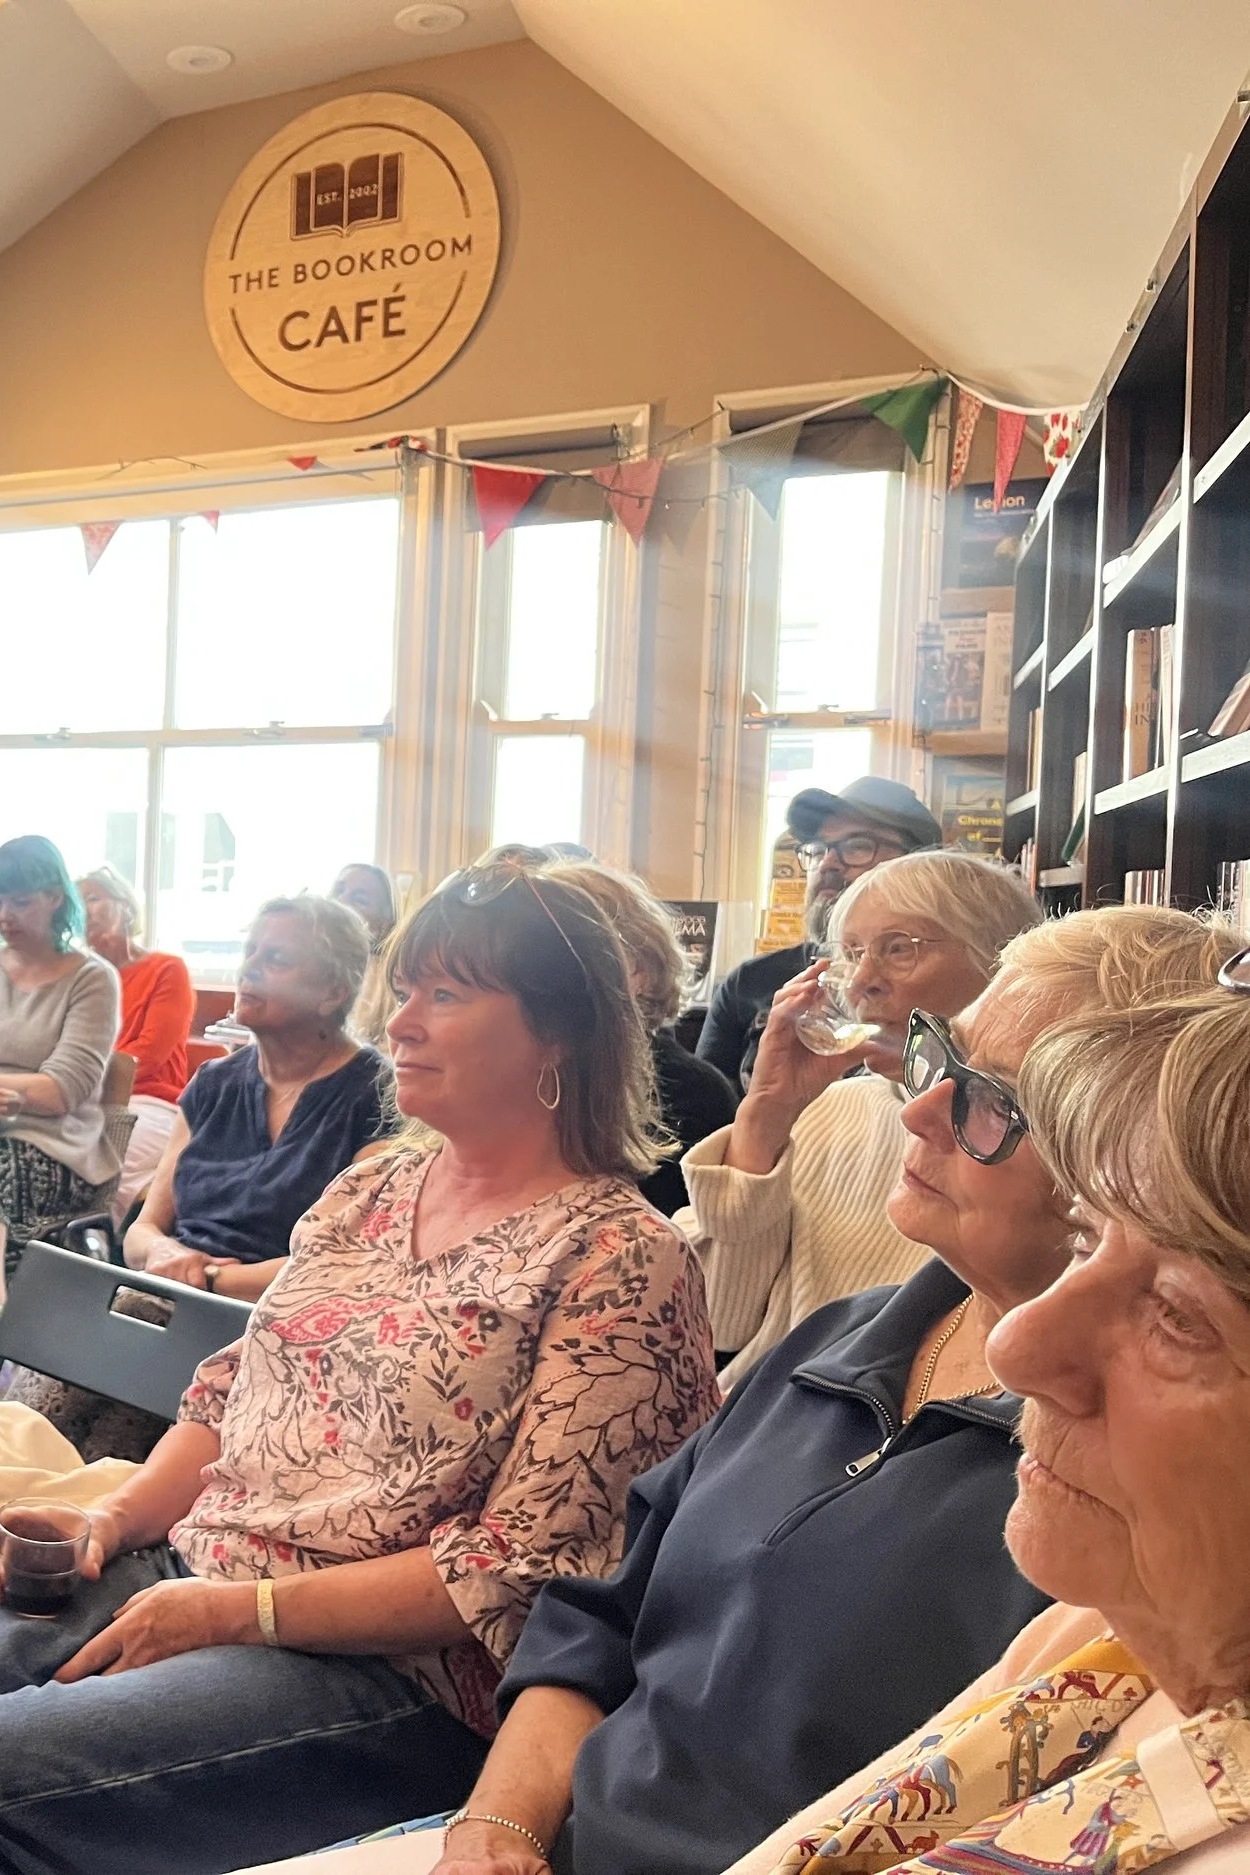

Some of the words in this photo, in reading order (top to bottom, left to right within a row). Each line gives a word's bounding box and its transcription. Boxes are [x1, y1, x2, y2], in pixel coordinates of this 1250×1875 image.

[316, 191, 342, 206] EST.
[349, 183, 378, 199] 2002
[229, 267, 279, 294] THE
[293, 234, 472, 284] BOOKROOM
[278, 282, 406, 352] CAFÉ
[974, 495, 1025, 510] Leion
